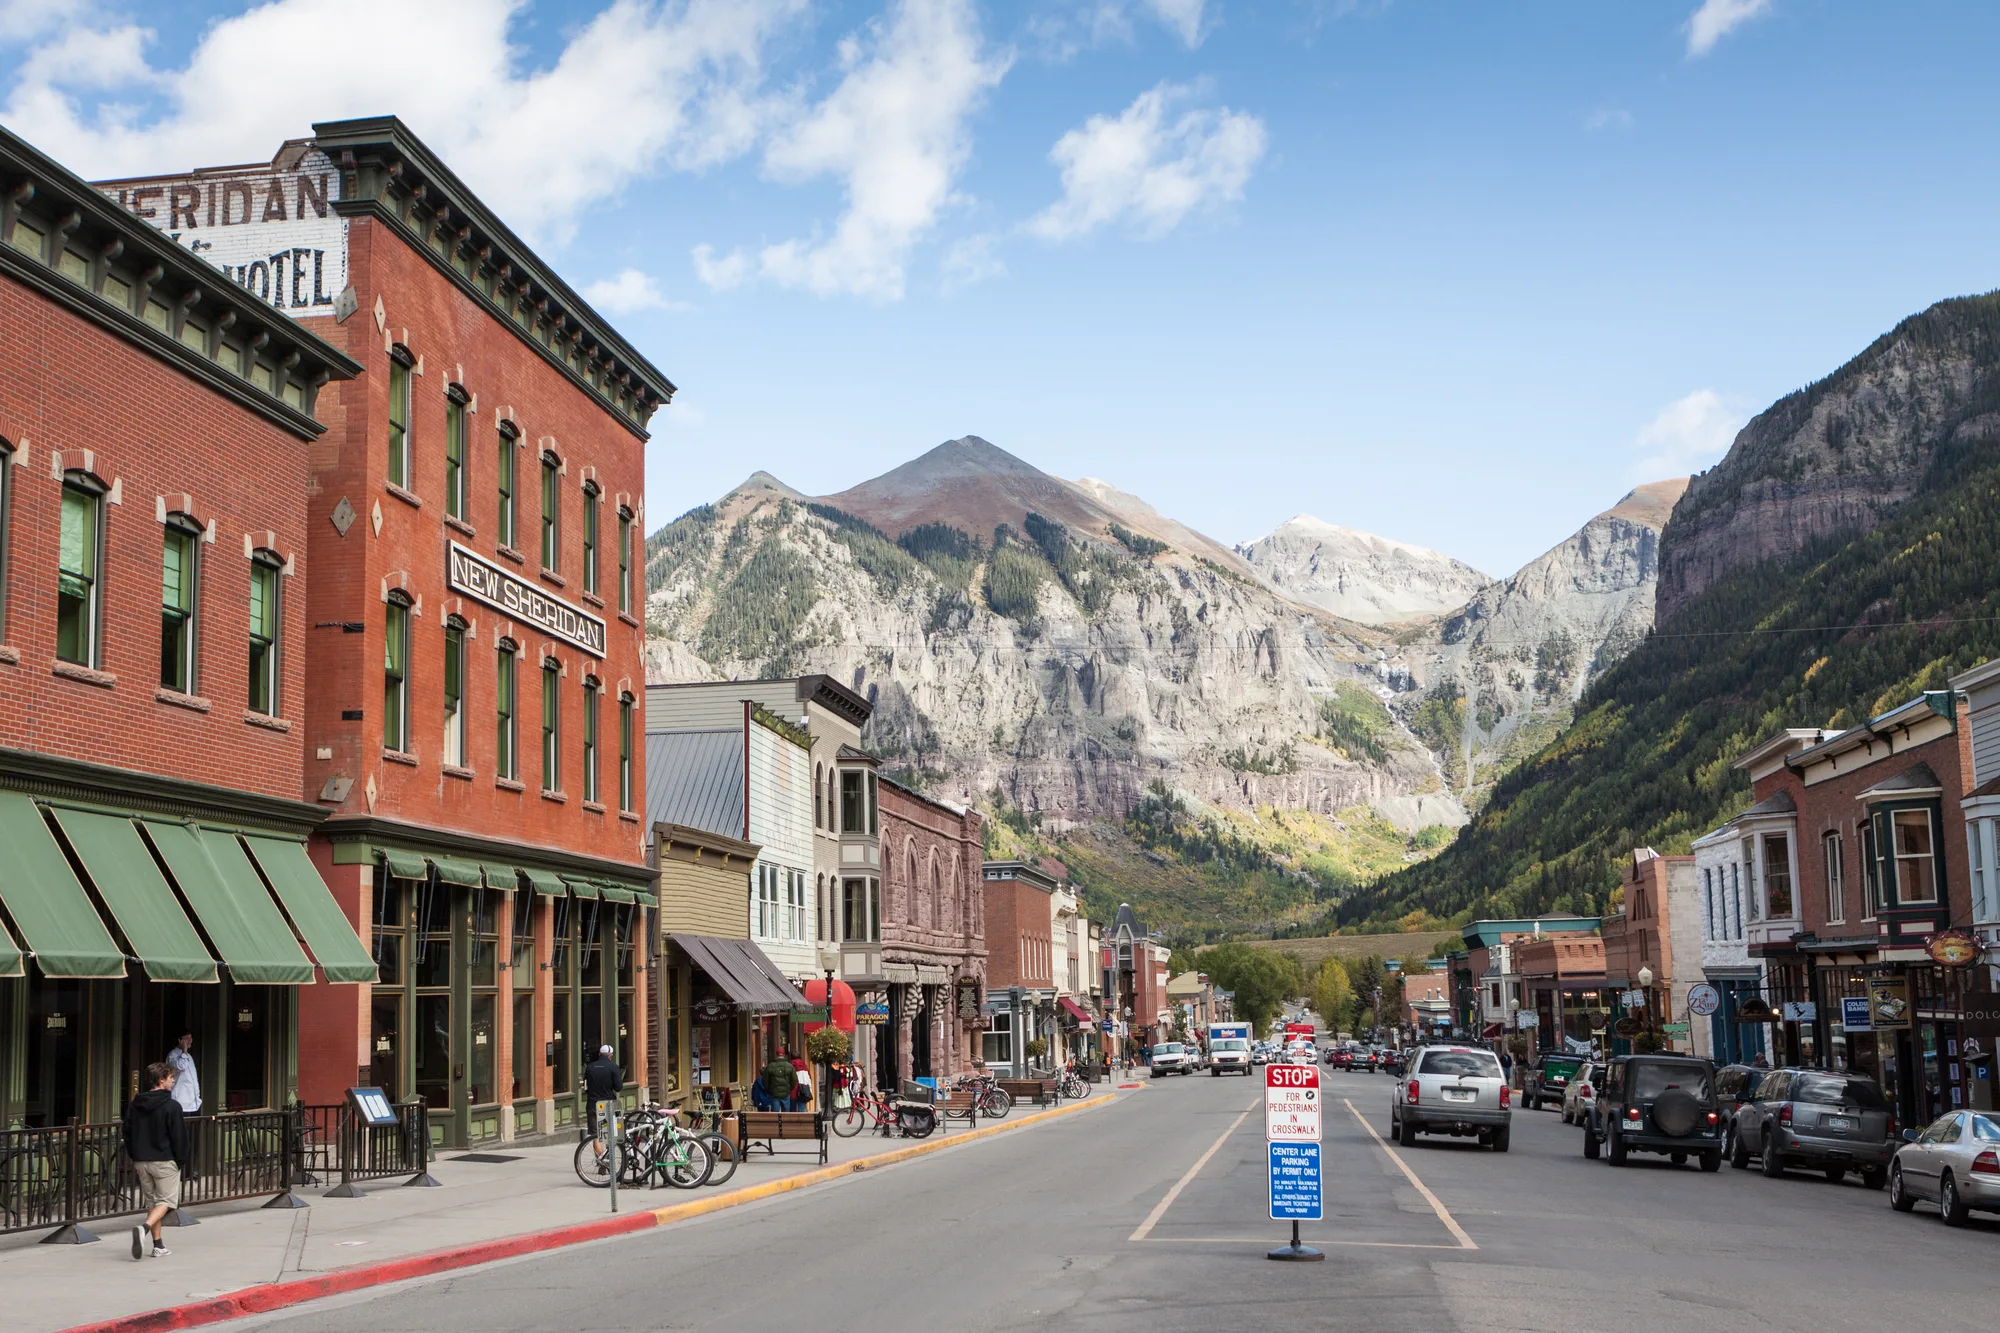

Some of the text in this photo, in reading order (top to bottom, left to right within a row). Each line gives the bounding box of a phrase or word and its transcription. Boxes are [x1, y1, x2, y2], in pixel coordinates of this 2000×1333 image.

[452, 552, 499, 601] NEW
[1689, 995, 1706, 1009] Zia
[1698, 1002, 1715, 1013] Sun
[700, 1013, 719, 1021] COFFEE
[856, 1013, 889, 1021] PARAGON
[1272, 1068, 1313, 1086] STOP
[1978, 1067, 1987, 1079] P
[1286, 1092, 1301, 1102] FOR
[1269, 1103, 1318, 1113] PEDESTRIANS
[1290, 1114, 1298, 1123] IN
[1272, 1124, 1316, 1135] CROSSWALK
[1272, 1147, 1318, 1157] CENTER LANE
[1281, 1157, 1309, 1166] PARKING
[1272, 1167, 1318, 1176] BY PERMIT ONLY
